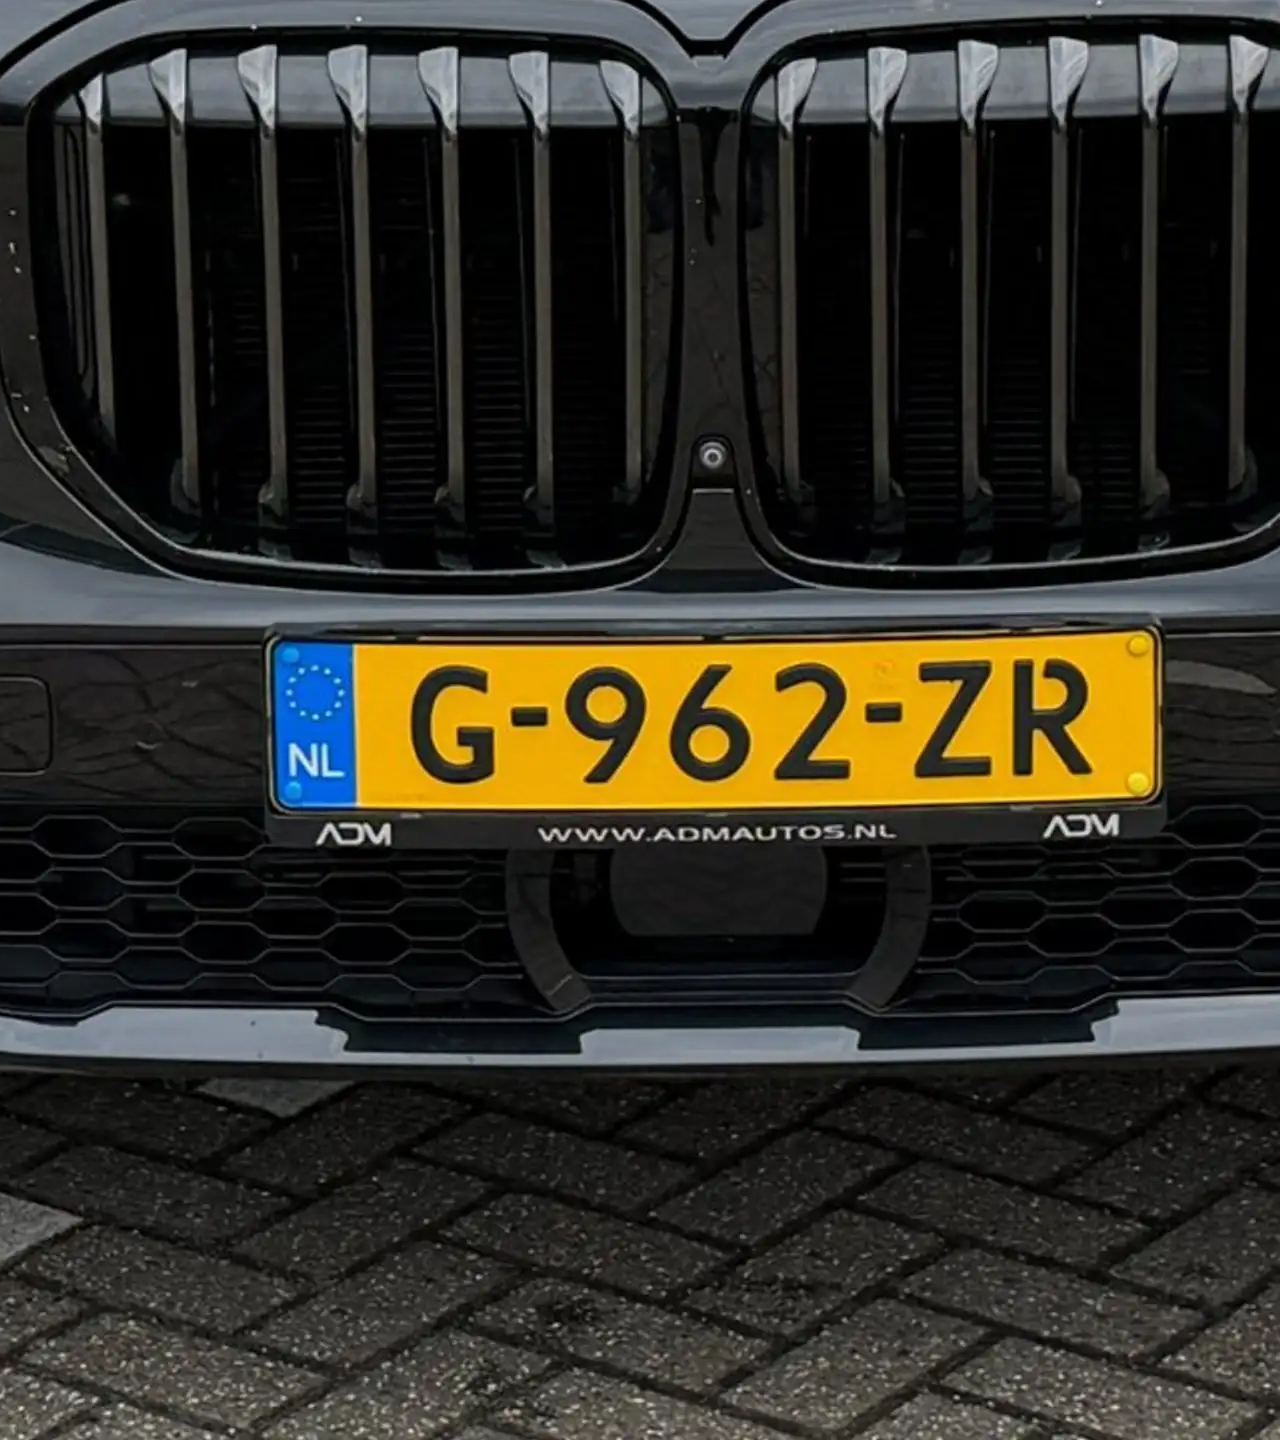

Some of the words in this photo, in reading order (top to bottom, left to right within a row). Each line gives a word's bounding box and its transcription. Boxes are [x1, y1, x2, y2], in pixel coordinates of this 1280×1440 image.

[410, 659, 1093, 785] G-962-ZR
[288, 742, 345, 778] NL
[316, 822, 392, 847] ADM
[538, 824, 897, 843] WWW.ADMAUTOS.NL
[1042, 812, 1120, 839] ADM
